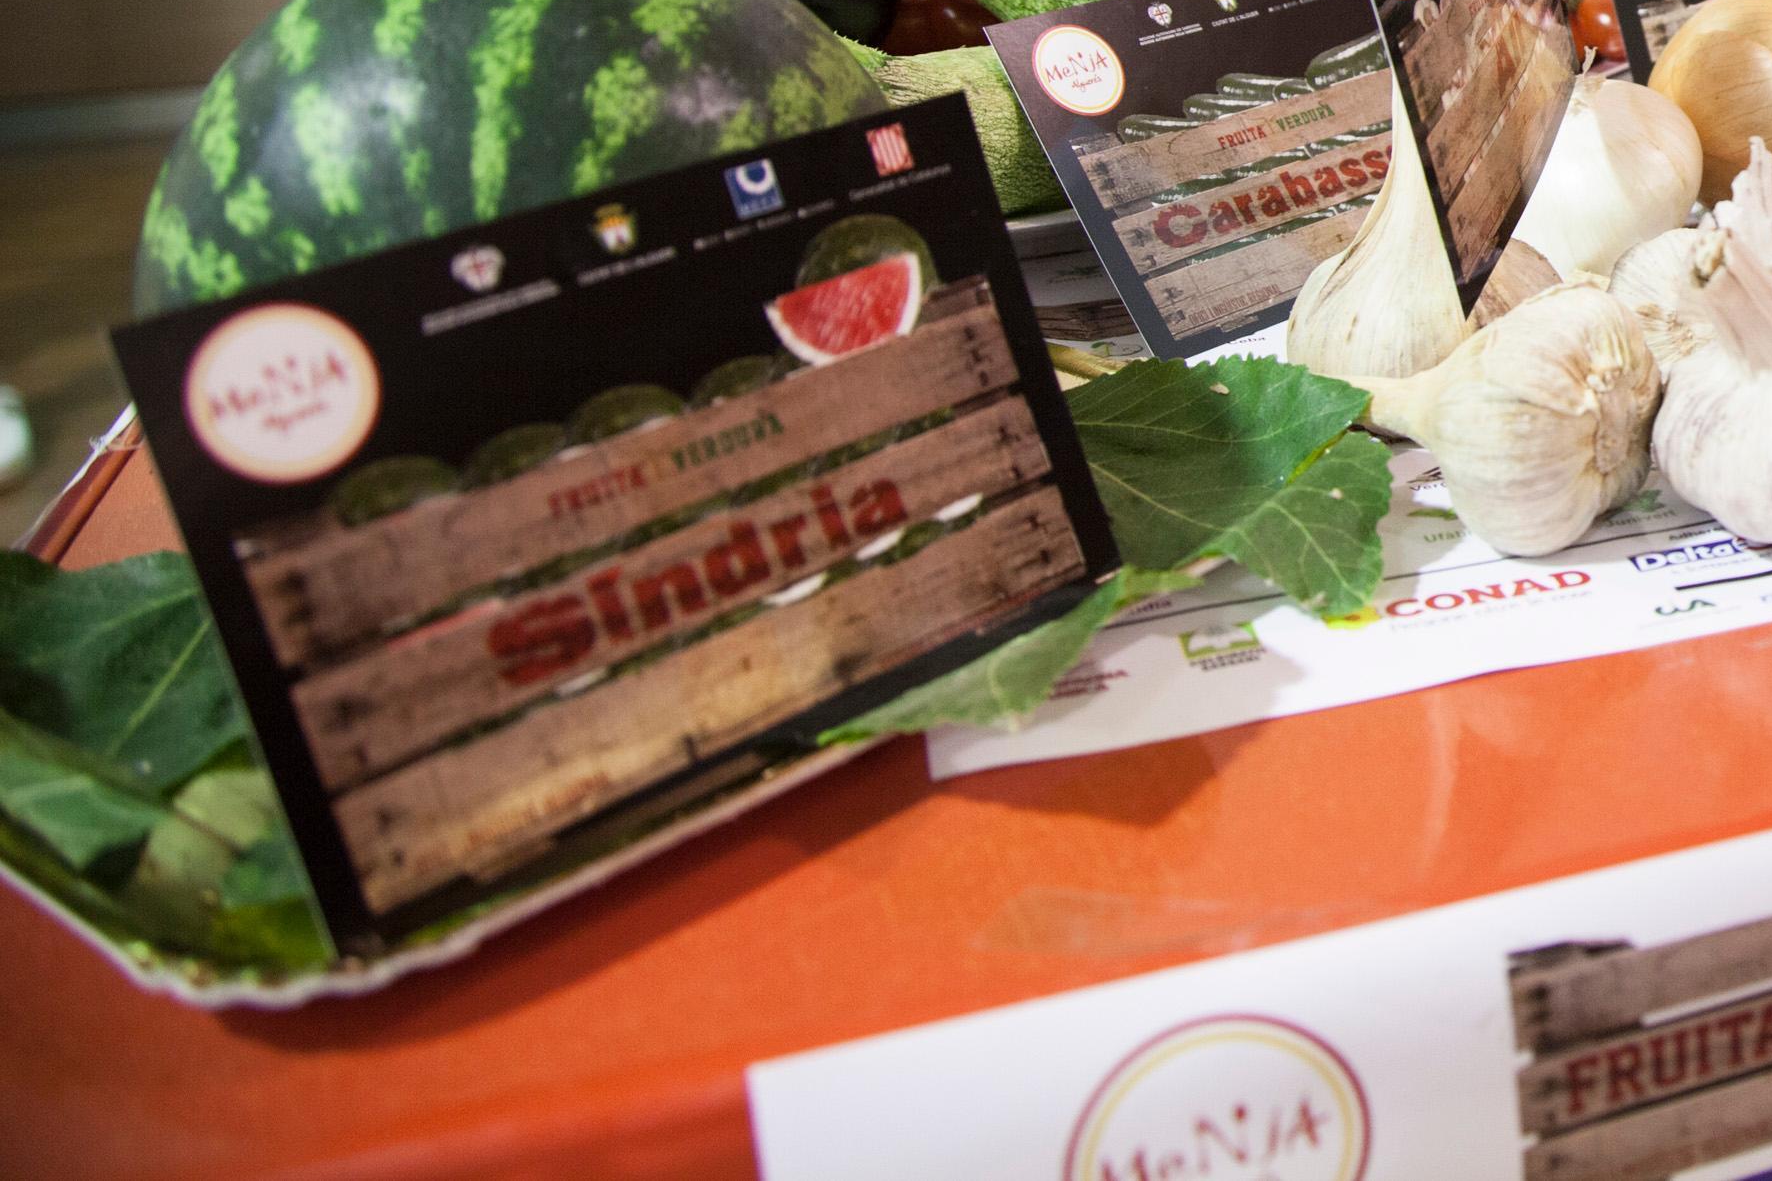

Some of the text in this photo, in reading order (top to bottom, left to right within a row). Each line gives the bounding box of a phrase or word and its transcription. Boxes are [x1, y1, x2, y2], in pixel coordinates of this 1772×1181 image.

[1217, 125, 1267, 149] FRUITA
[1152, 144, 1393, 249] Carabass
[548, 465, 646, 517] FRUITA
[1385, 569, 1592, 618] CONAD
